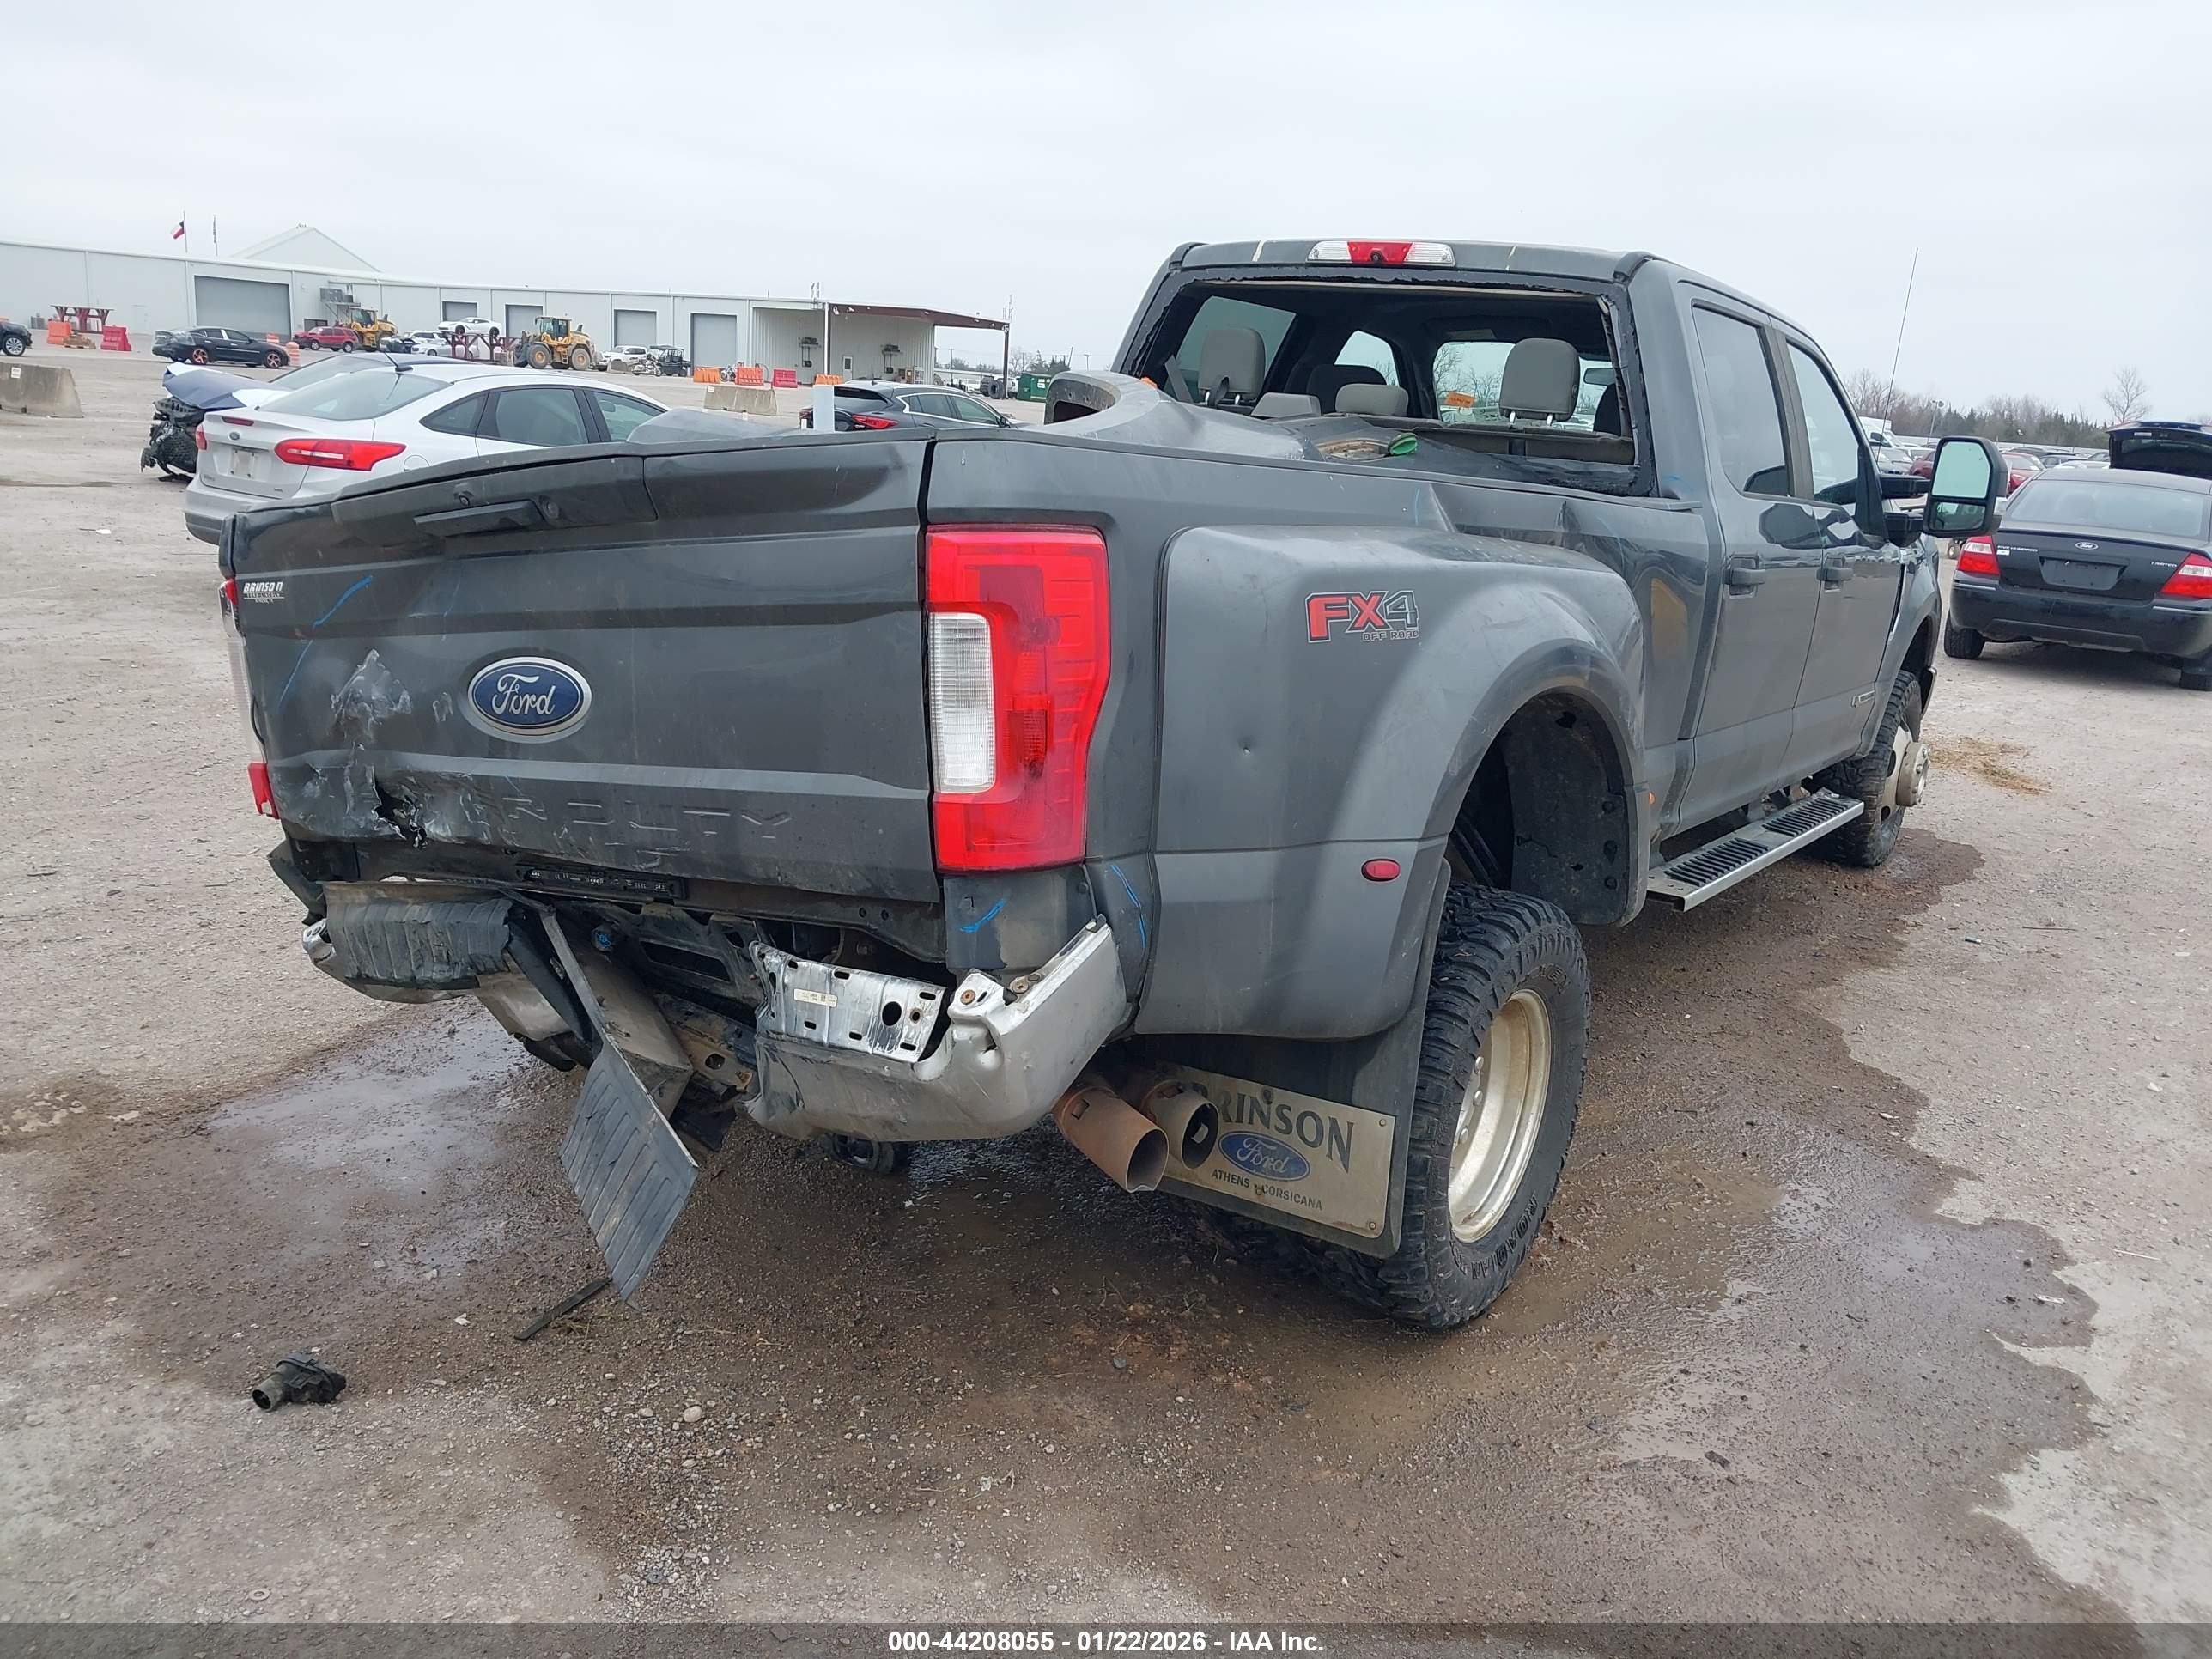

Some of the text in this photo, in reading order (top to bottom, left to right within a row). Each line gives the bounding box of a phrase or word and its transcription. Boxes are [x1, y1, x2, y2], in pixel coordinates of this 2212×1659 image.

[1304, 589, 1419, 643] FX4
[1362, 629, 1420, 642] OFF ROAD
[491, 673, 557, 715] Ford
[1191, 1080, 1355, 1174] RINSON
[1237, 1136, 1290, 1174] Ford
[1211, 1168, 1323, 1212] ATHENS CORSICANA
